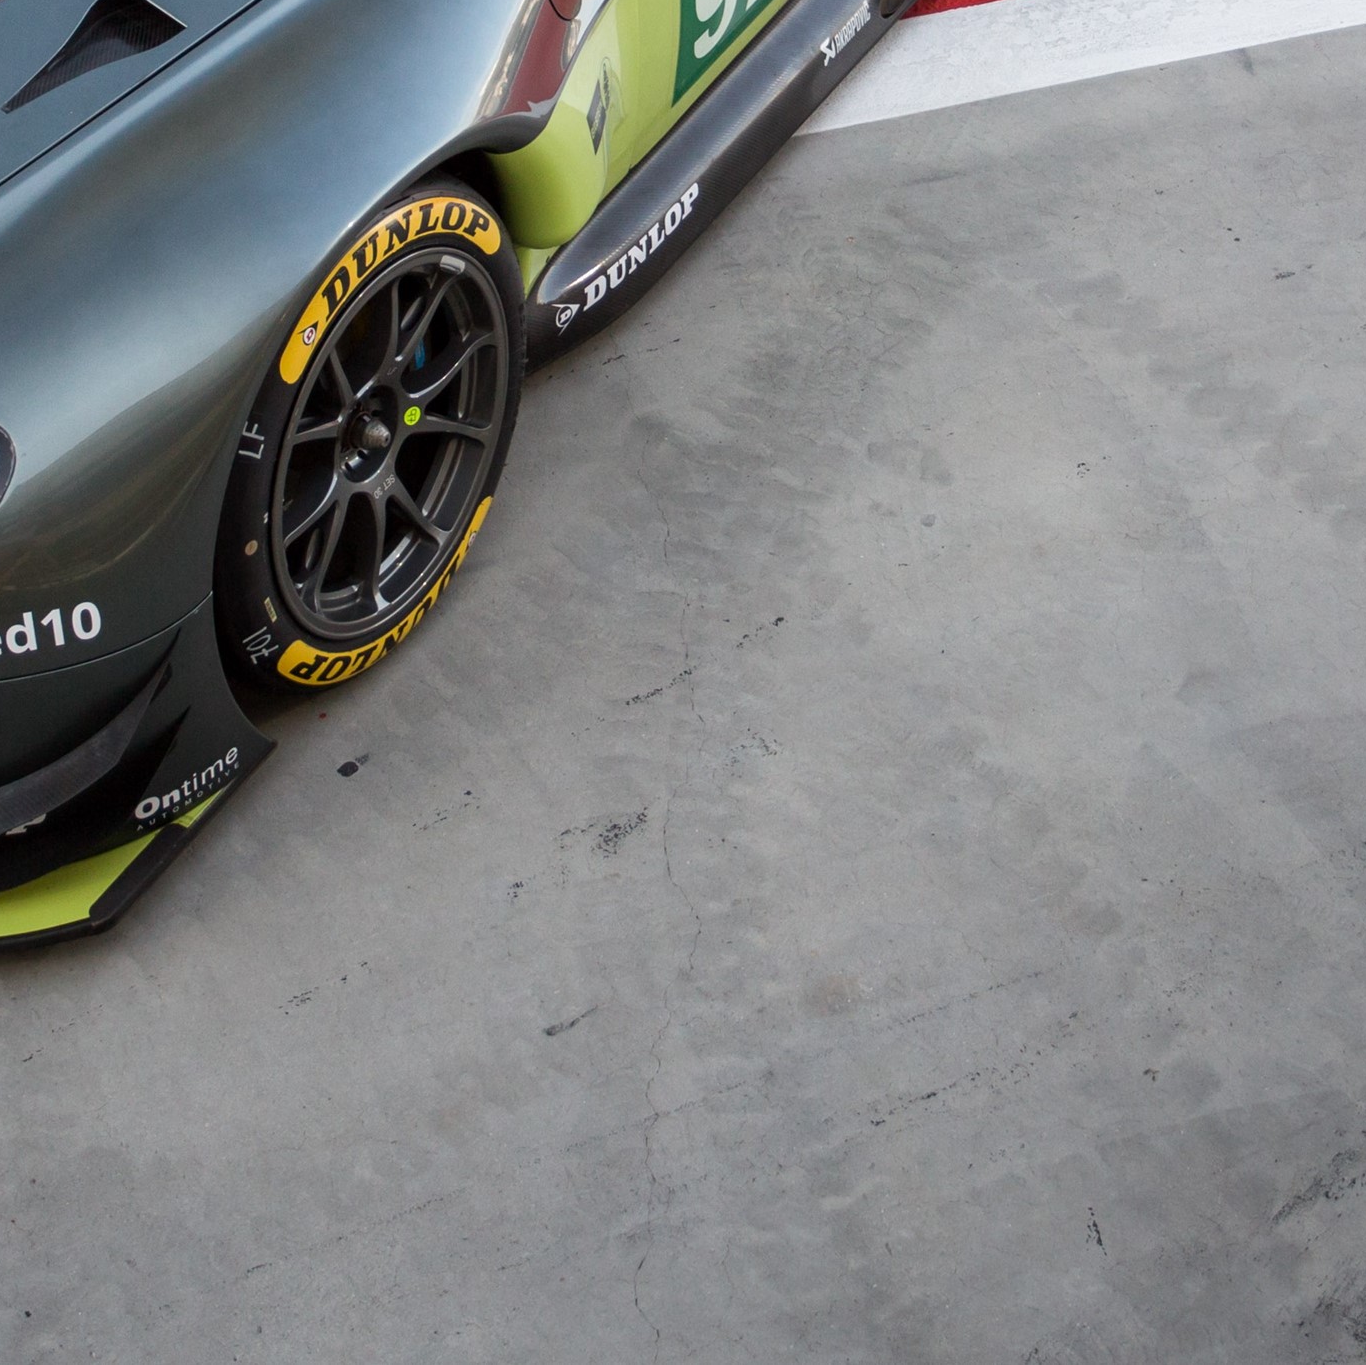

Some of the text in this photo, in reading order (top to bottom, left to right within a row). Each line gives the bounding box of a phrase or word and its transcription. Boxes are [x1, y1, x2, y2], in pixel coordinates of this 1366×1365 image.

[321, 201, 490, 322] DUNLOP
[583, 182, 699, 311] DUNLOP
[238, 421, 265, 460] LF
[381, 474, 396, 491] SET
[135, 746, 238, 820] Ontime
[137, 761, 240, 832] AUTOMOTIVE
